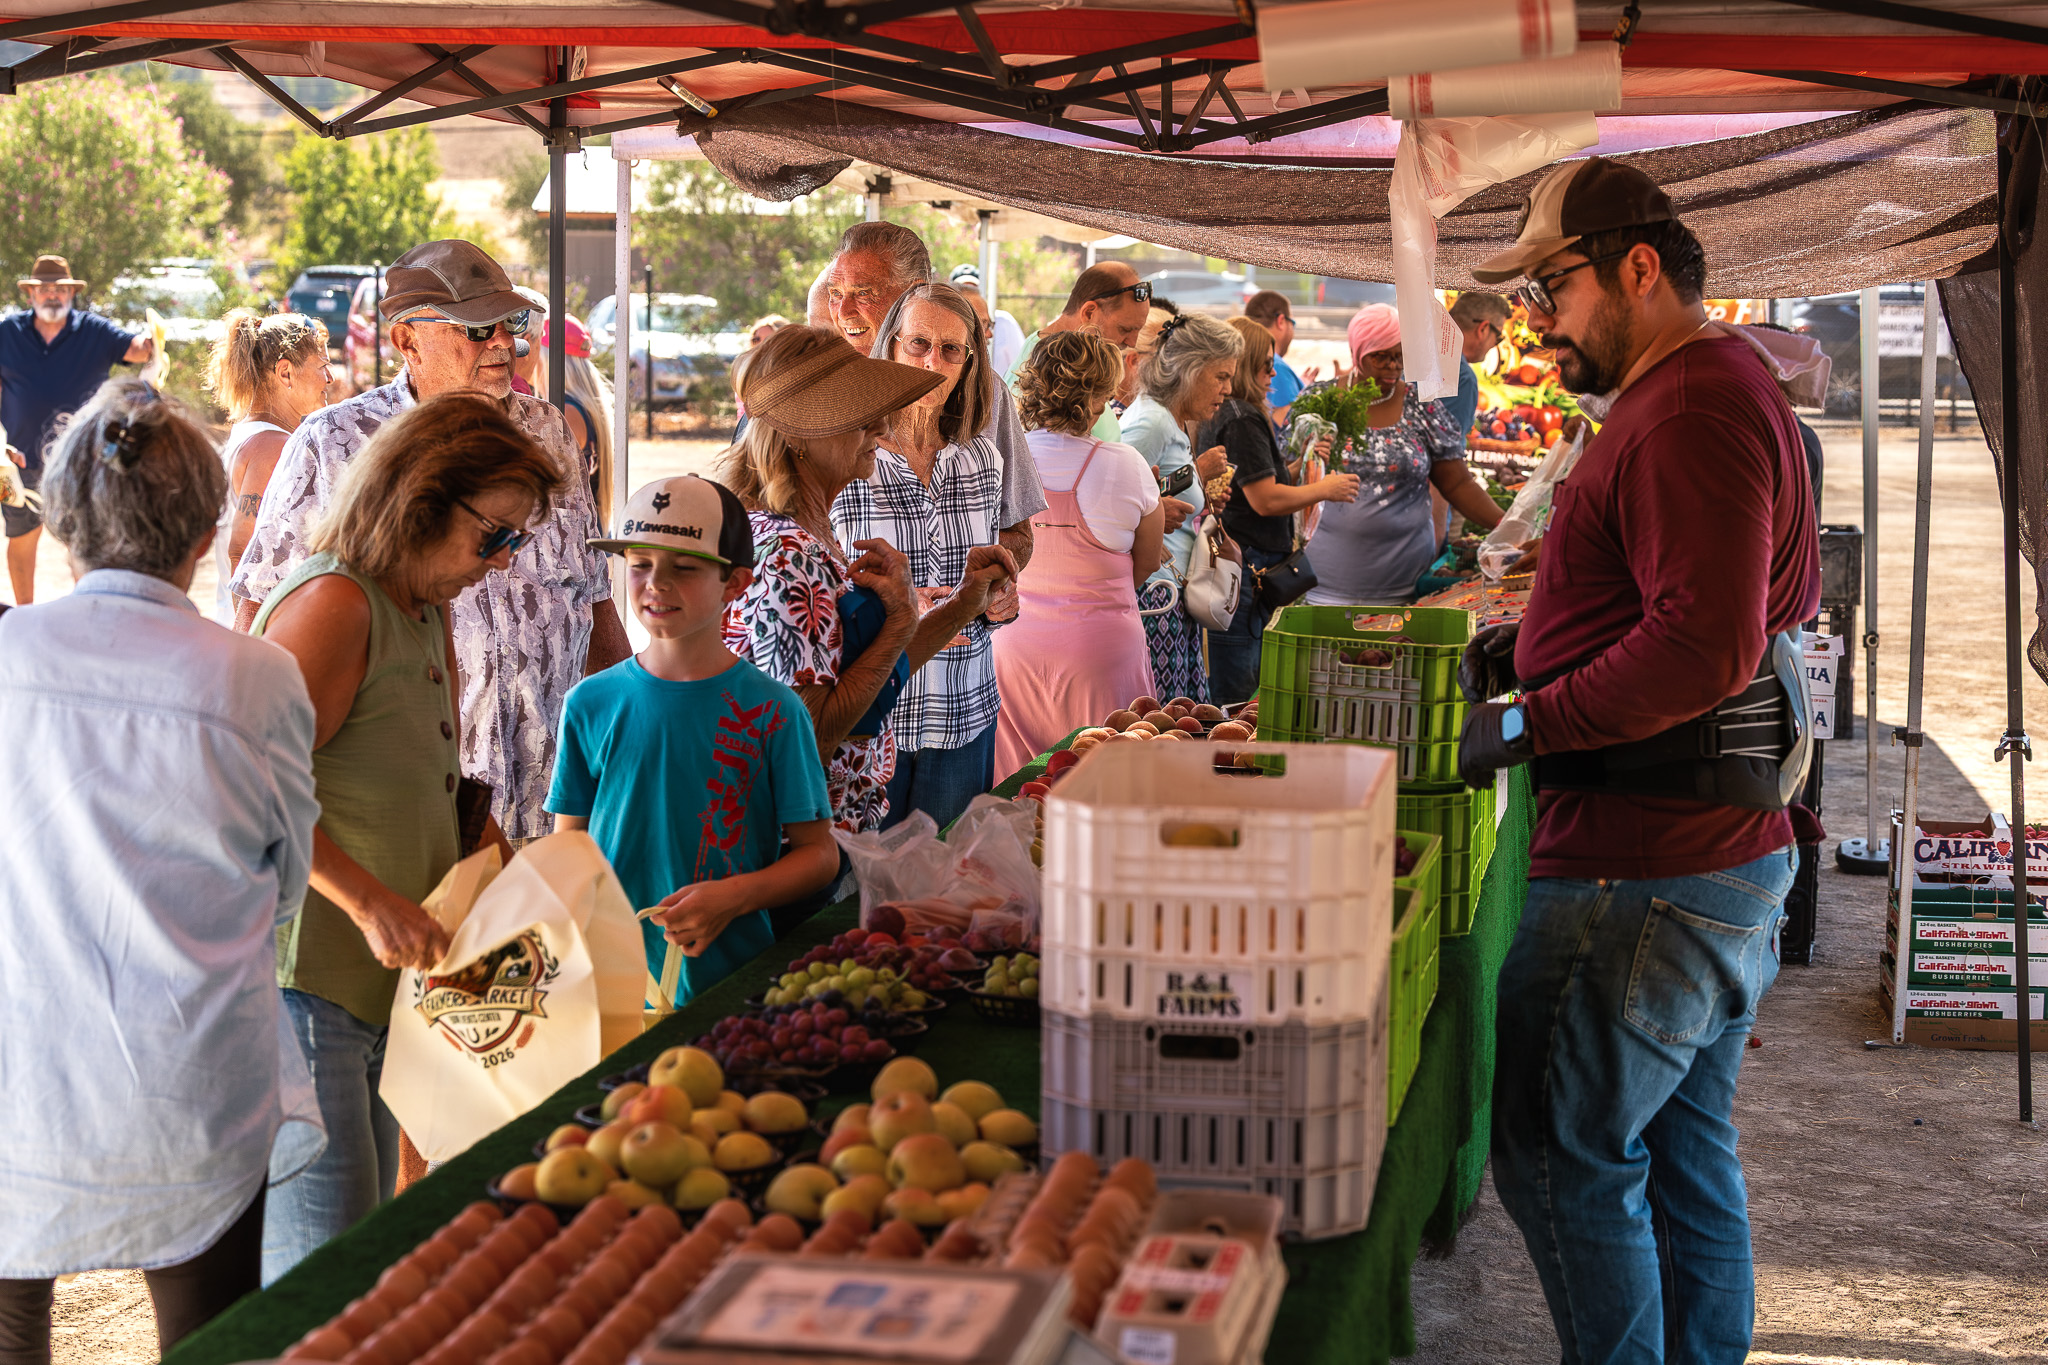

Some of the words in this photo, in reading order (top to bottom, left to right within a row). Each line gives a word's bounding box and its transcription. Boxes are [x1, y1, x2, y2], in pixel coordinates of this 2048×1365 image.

[635, 520, 703, 540] Kawasaki
[1920, 930, 1969, 939] California
[1974, 931, 2009, 940] grown
[1934, 941, 1993, 949] BUSHBERRIES
[1918, 962, 1968, 972] California
[1973, 963, 2007, 973] grown
[1167, 972, 1184, 992] R
[1190, 972, 1209, 993] &
[481, 988, 528, 1005] RKET
[1157, 994, 1242, 1016] FARMS
[1910, 999, 1961, 1008] California
[1965, 1001, 1999, 1009] grown
[1924, 1010, 1983, 1018] BUSHBERRIES
[1930, 1033, 1960, 1042] Grown
[1963, 1034, 1986, 1043] Fresh
[481, 1047, 515, 1069] 2026
